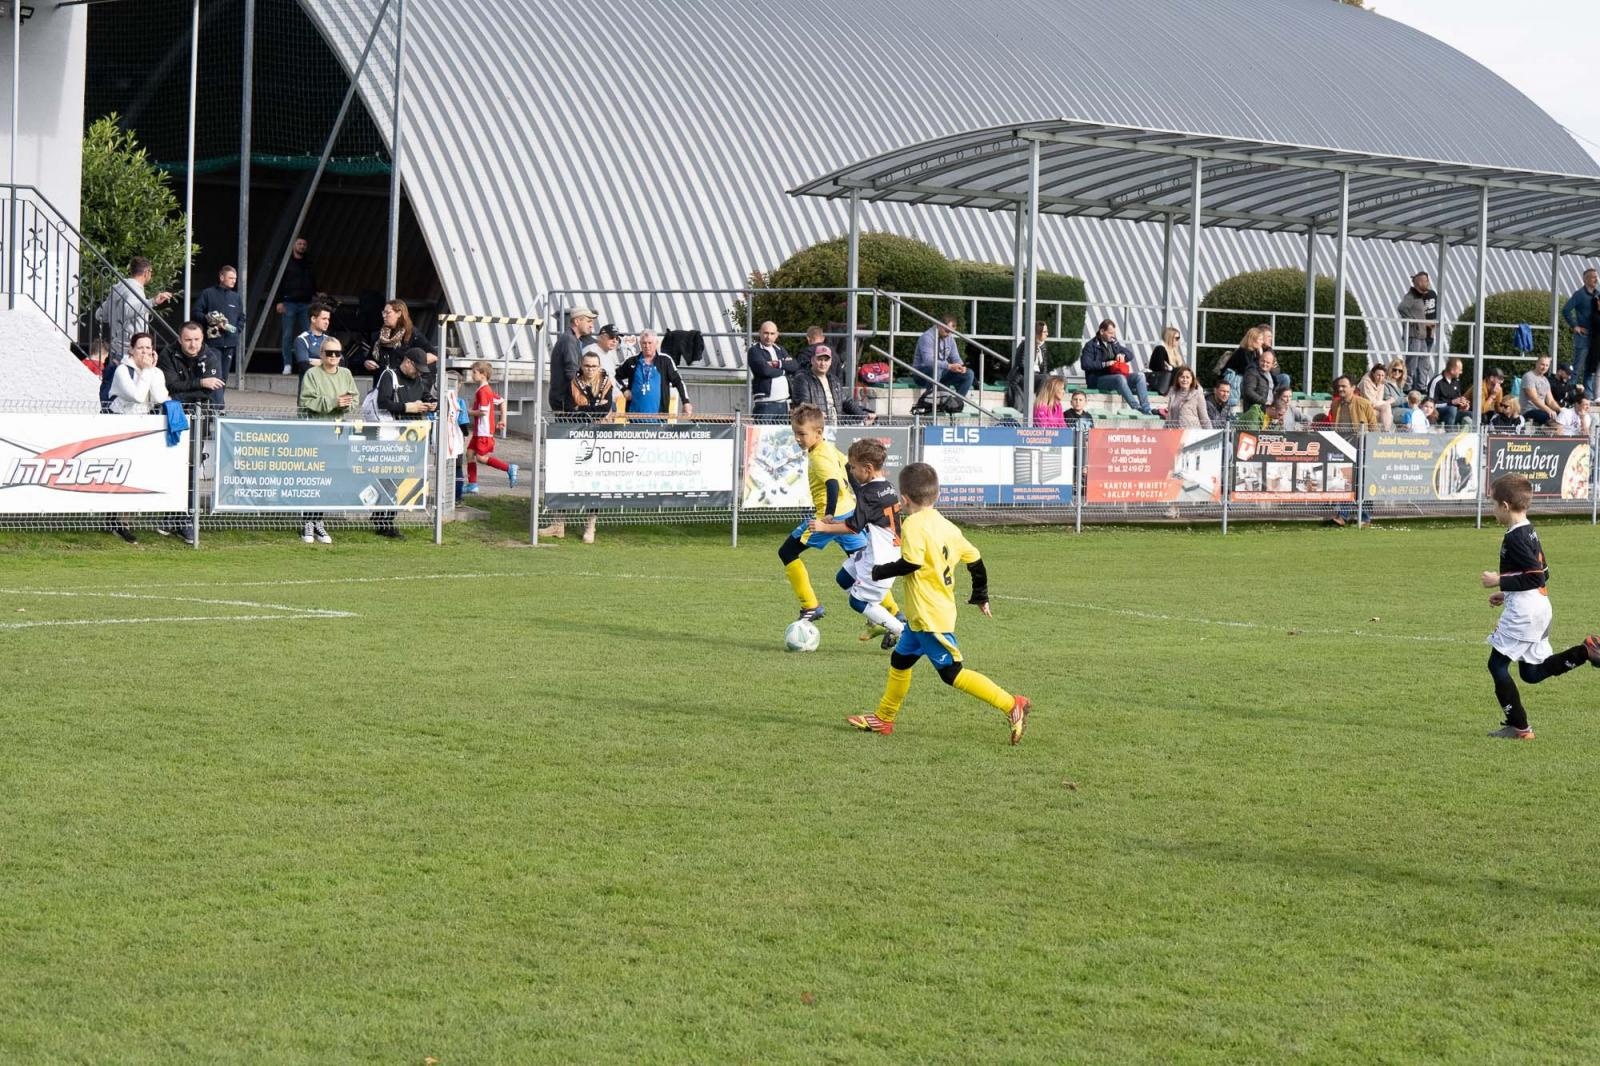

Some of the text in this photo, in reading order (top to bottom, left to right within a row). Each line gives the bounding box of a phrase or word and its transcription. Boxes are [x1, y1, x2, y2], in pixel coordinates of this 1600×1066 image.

[234, 431, 289, 443] ELEGANCKO
[614, 429, 657, 439] PRODUKTÓW
[679, 431, 690, 439] NA
[691, 431, 711, 439] CIEBIE
[942, 428, 980, 443] ELIS
[233, 446, 318, 457] MODNIE I SOLIDNIE
[1506, 442, 1532, 452] Pizzeria
[233, 461, 326, 472] USŁUGI BUDOWLANE
[1491, 445, 1560, 478] Annaberg
[2, 458, 132, 486] IMPACTO
[223, 476, 332, 486] BUDOWA DOMU OD PODSTAW
[234, 489, 321, 498] KRZYSZTOF MATUSZEK
